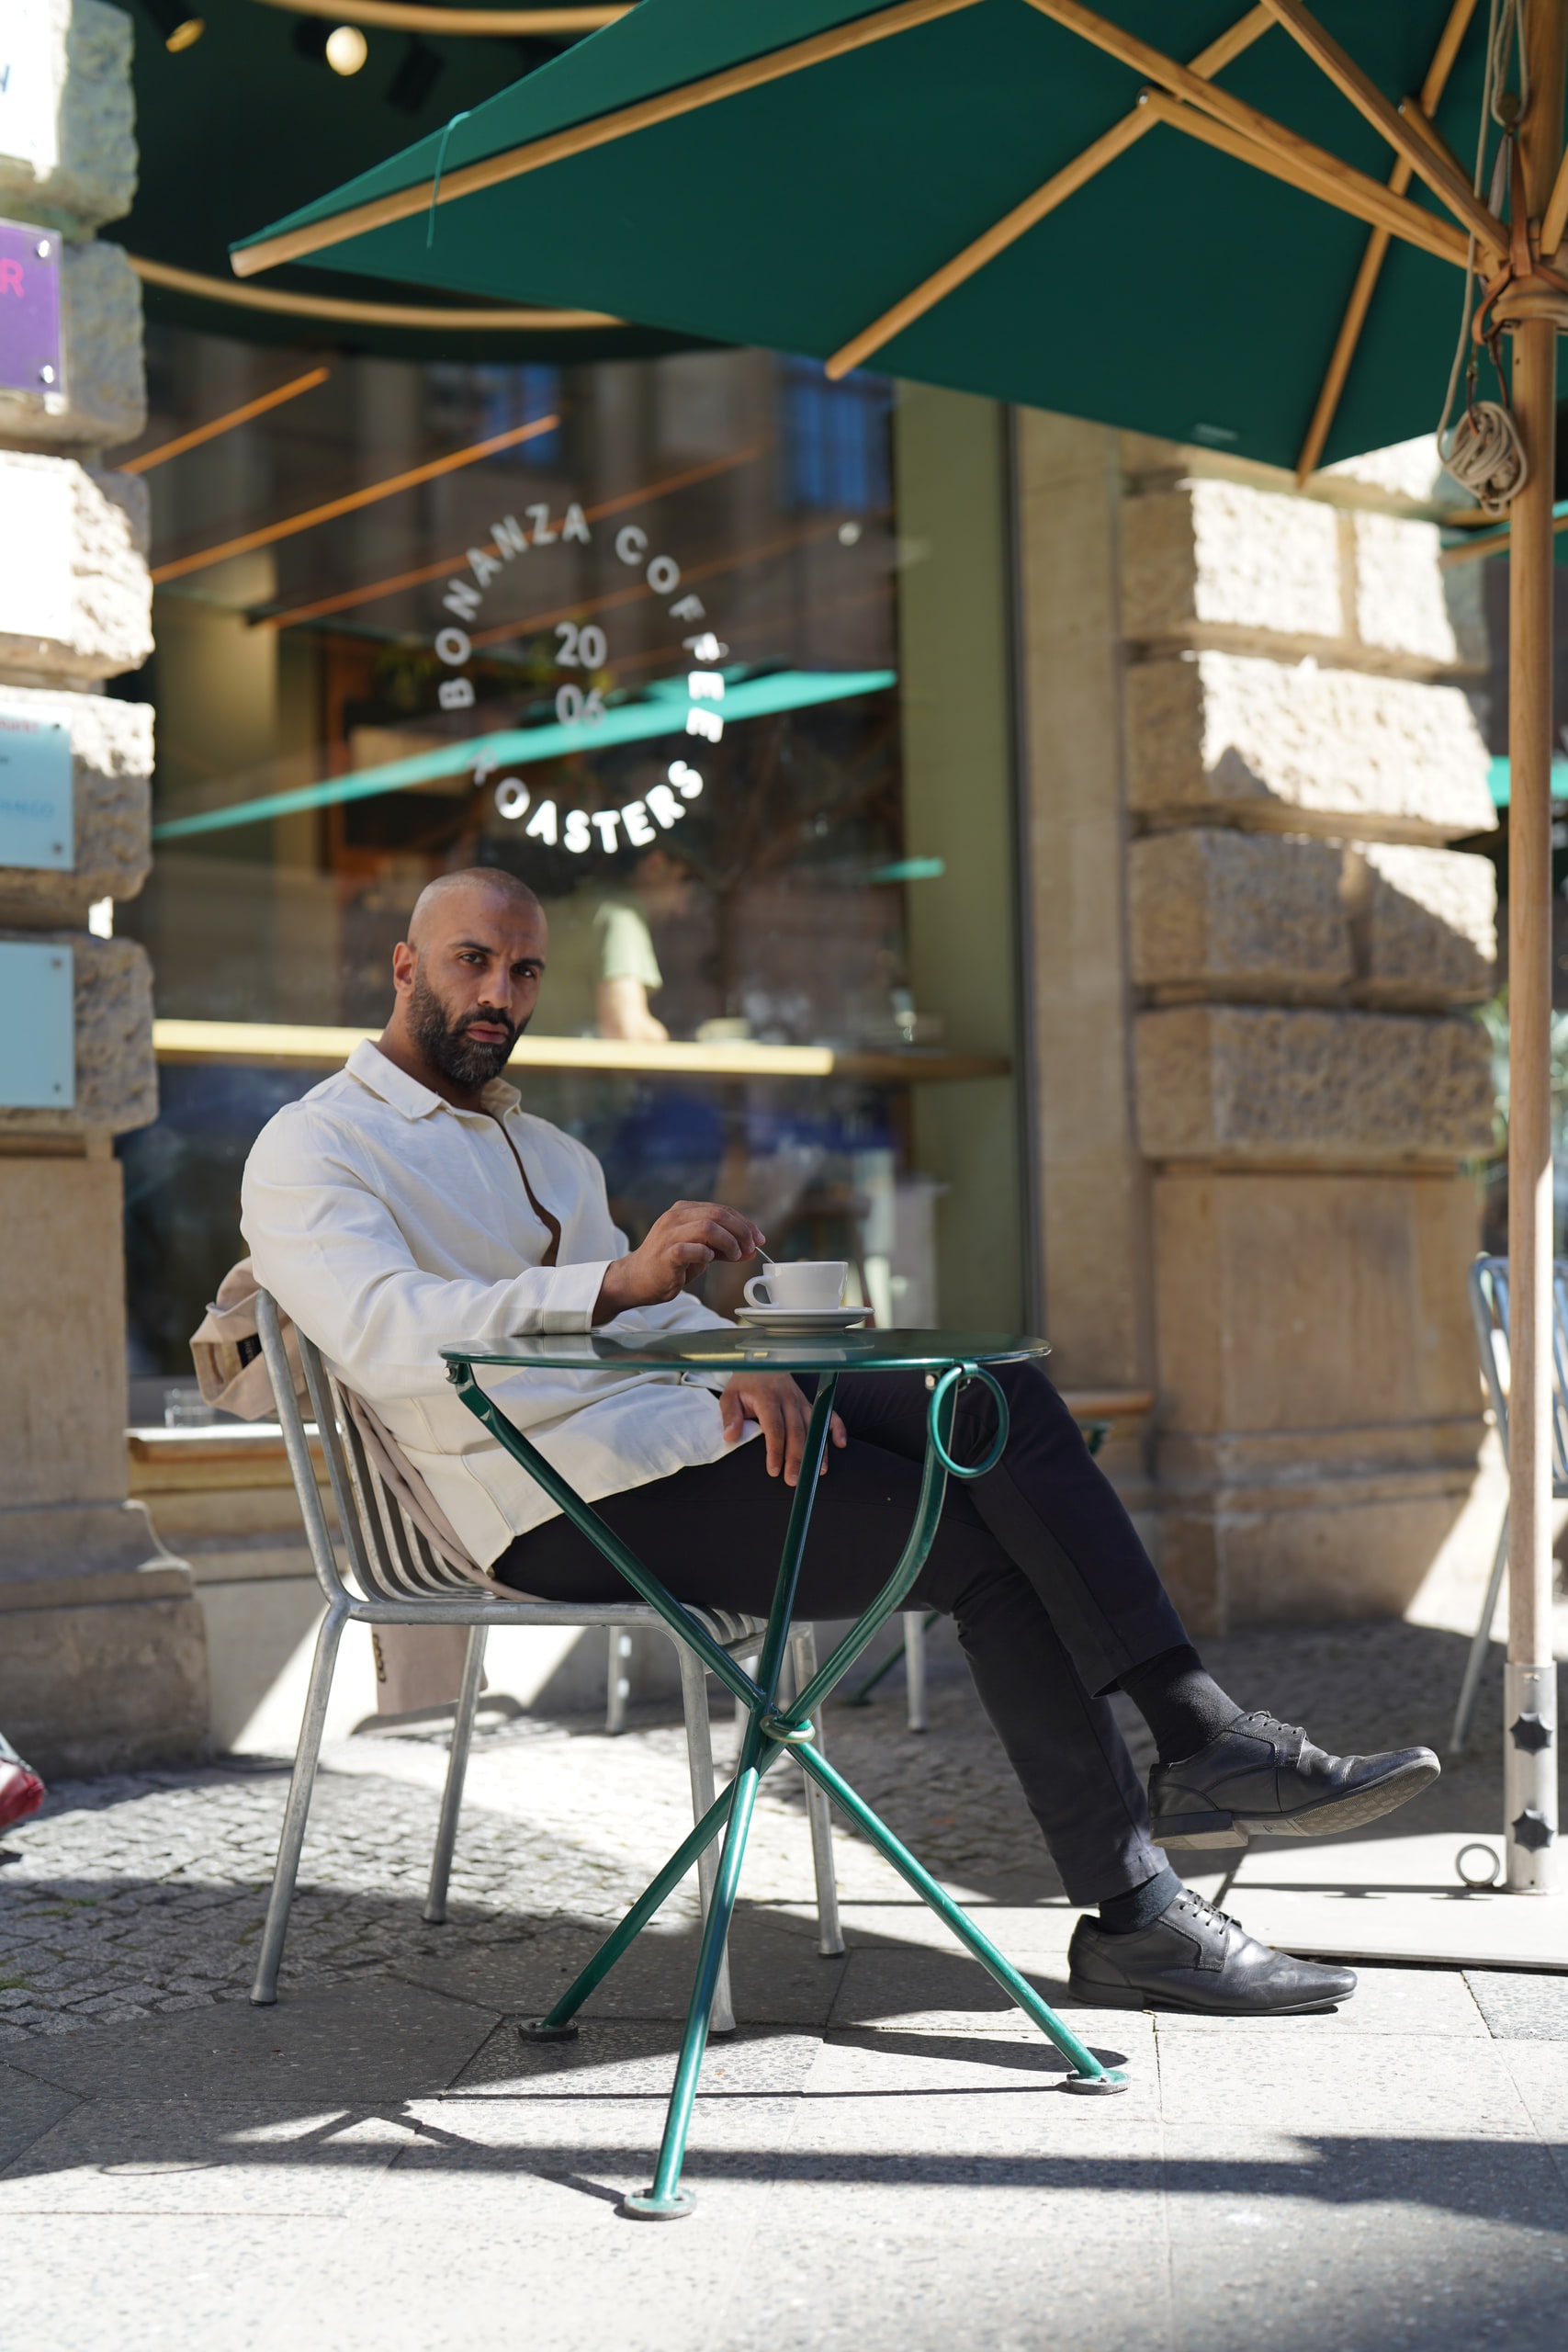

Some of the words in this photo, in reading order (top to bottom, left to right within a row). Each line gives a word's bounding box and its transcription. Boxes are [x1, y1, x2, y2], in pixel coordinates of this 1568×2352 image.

[434, 503, 592, 711] BONANZA
[554, 621, 607, 670] 20
[555, 684, 605, 729] 06
[467, 745, 704, 854] ROASTERS
